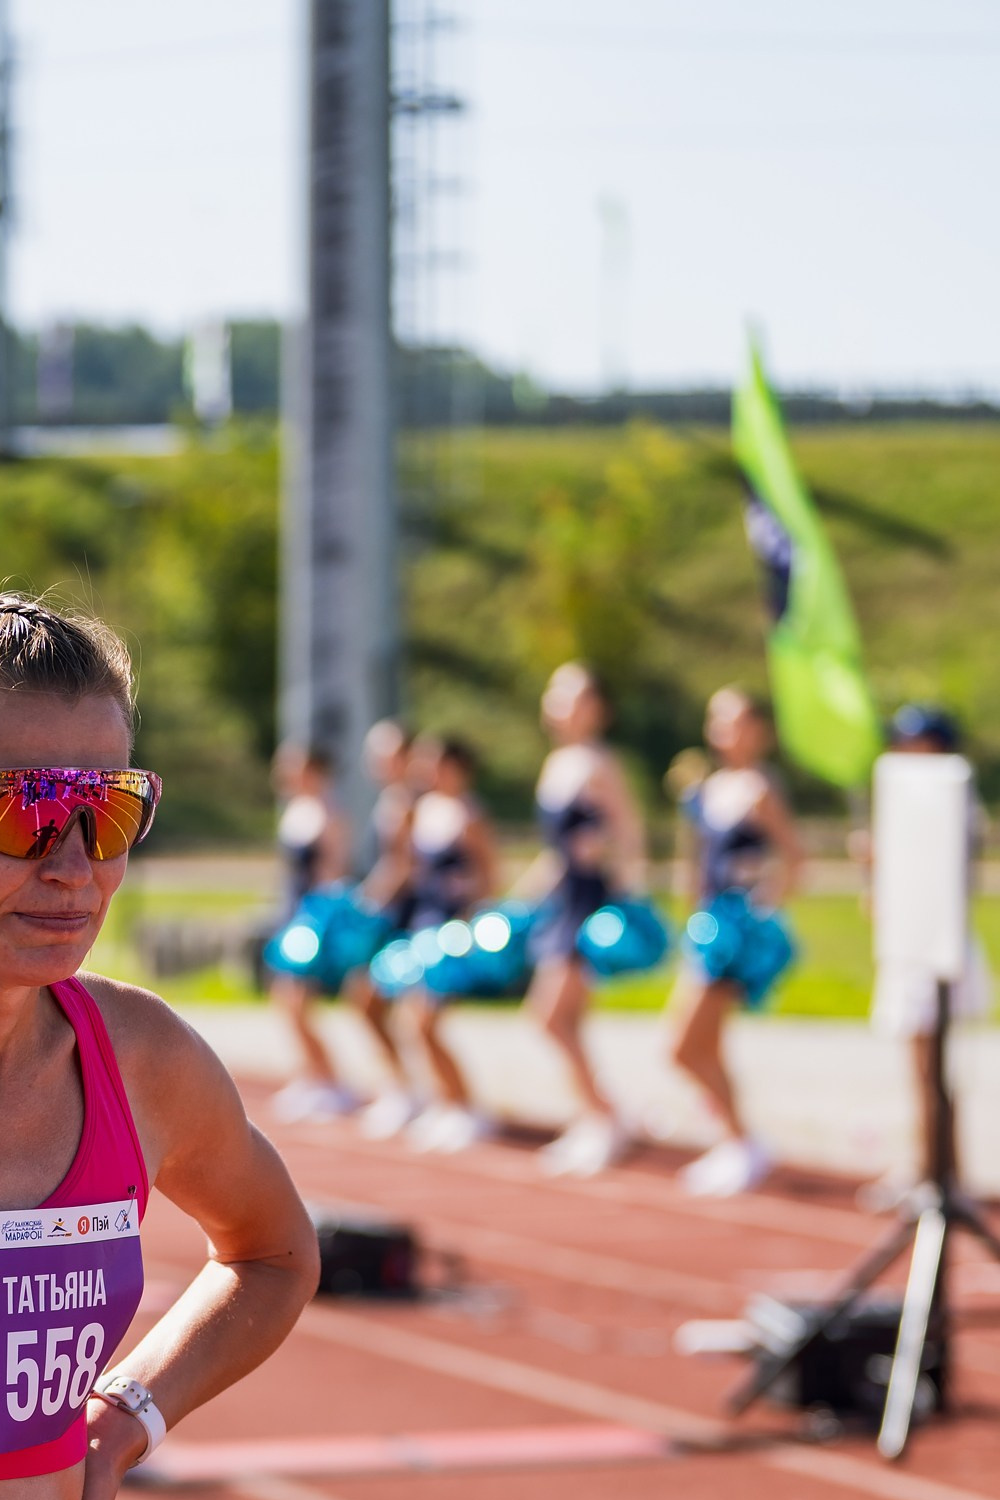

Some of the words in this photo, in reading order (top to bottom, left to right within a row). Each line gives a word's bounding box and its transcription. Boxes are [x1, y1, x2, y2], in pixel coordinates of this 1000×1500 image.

[5, 1230, 43, 1241] МАРАФОН
[92, 1215, 109, 1232] Пэй
[2, 1268, 107, 1315] ТАТЬЯНА
[5, 1322, 105, 1422] 558
